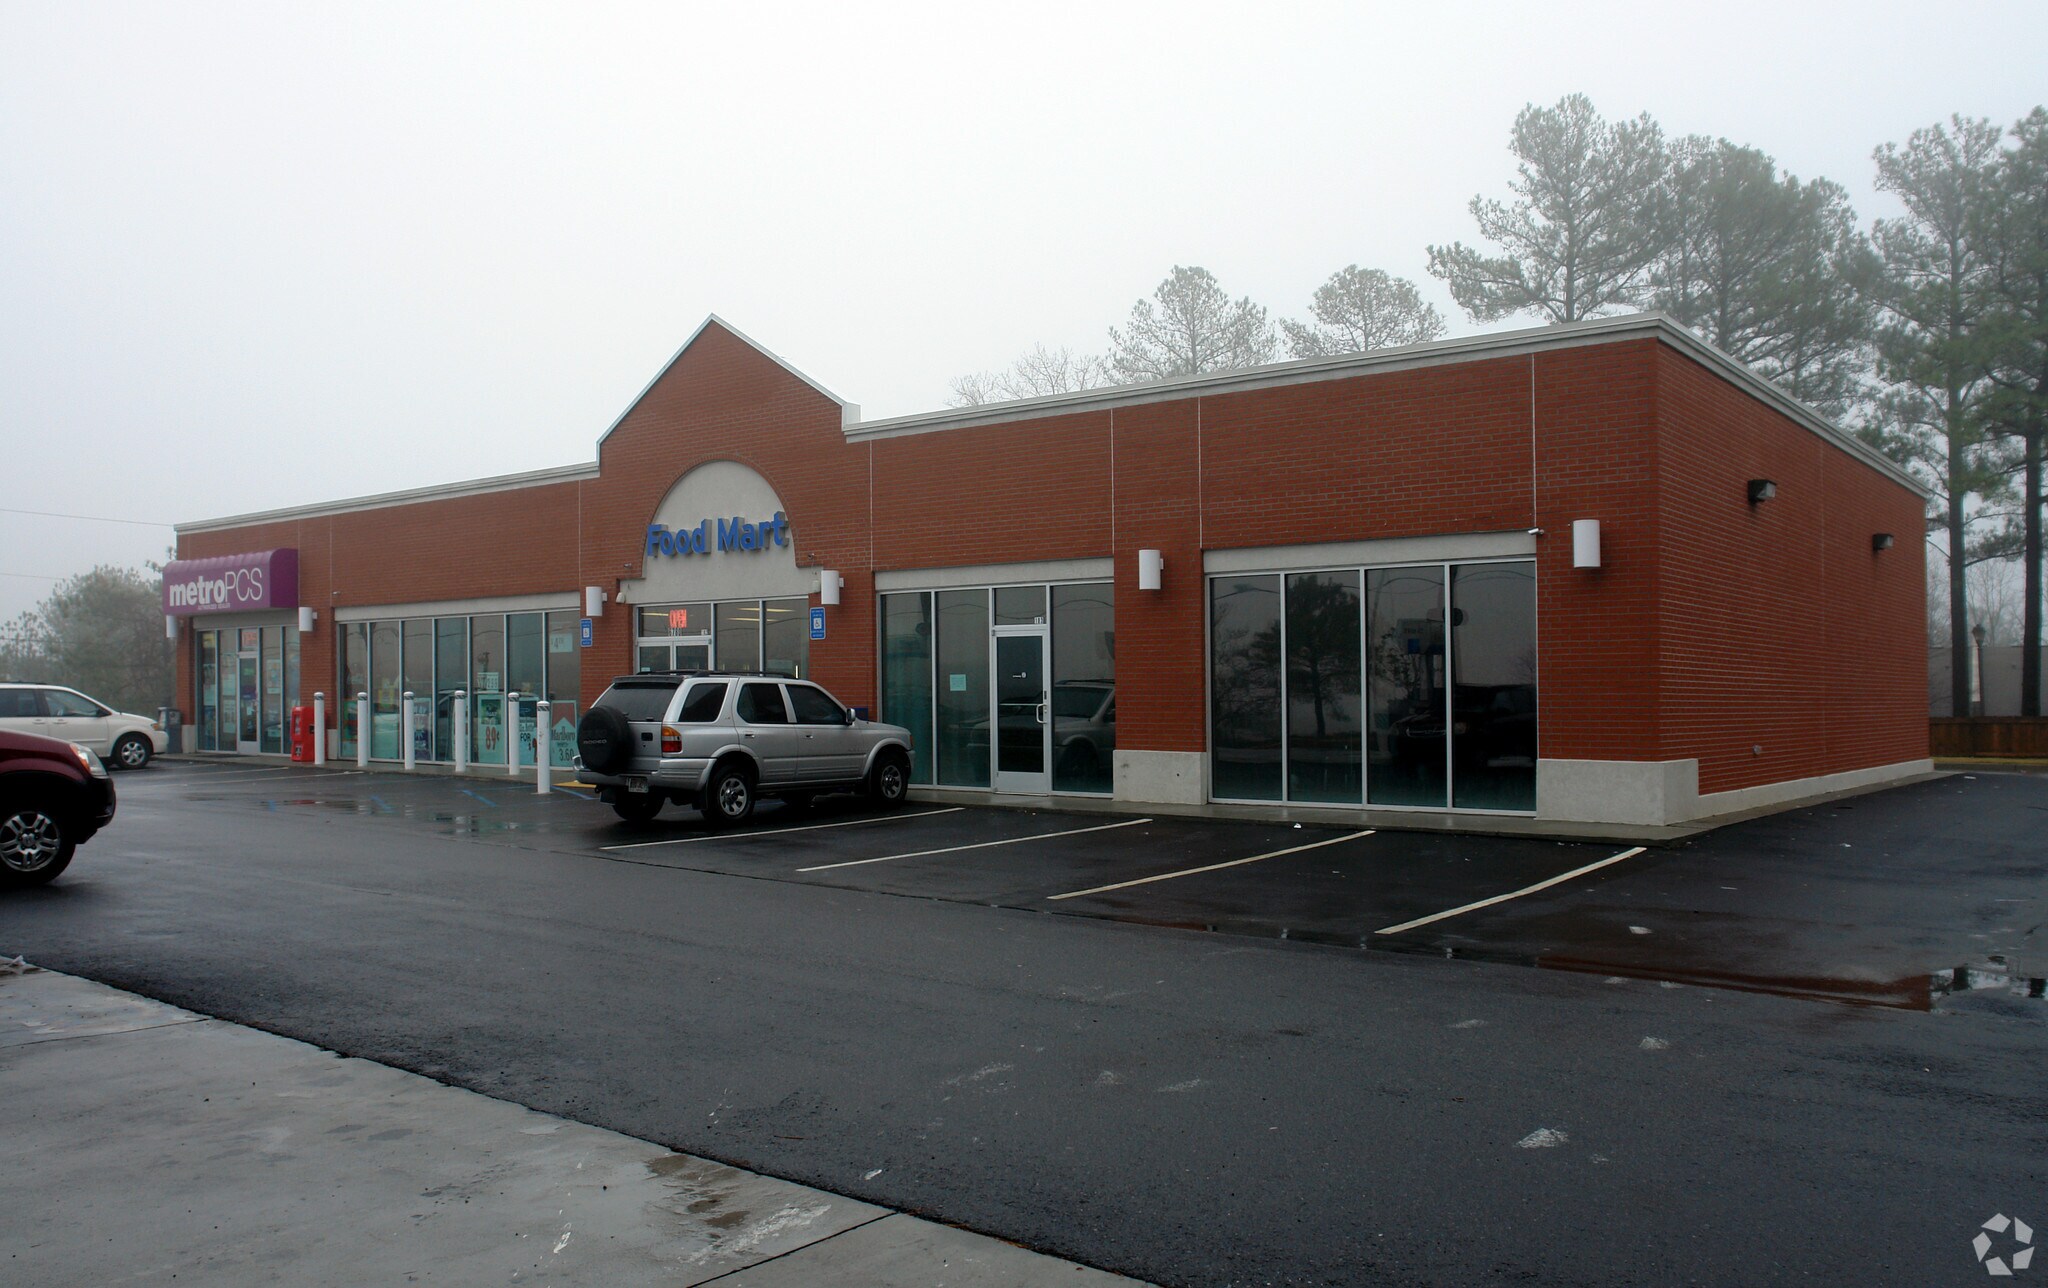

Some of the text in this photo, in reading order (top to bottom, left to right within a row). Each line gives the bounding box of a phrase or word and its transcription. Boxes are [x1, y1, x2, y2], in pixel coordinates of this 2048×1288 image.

[647, 511, 788, 557] Food Mart
[169, 567, 263, 606] metroPCS
[552, 726, 576, 741] Marlboro
